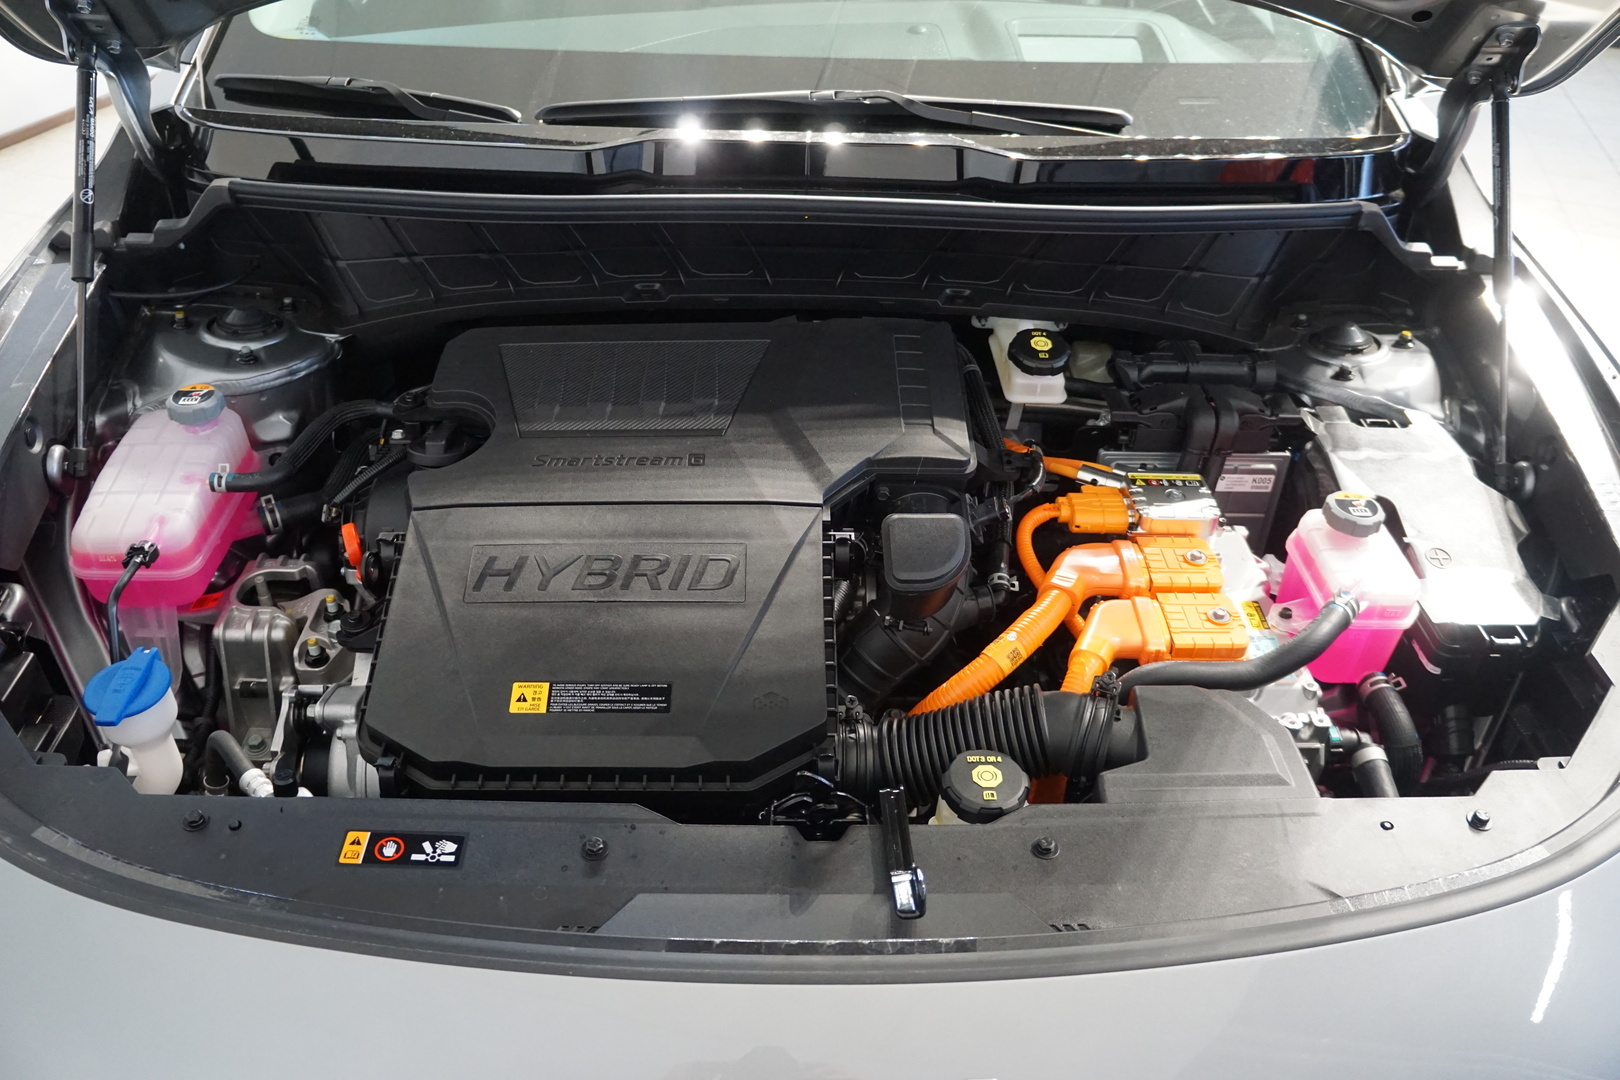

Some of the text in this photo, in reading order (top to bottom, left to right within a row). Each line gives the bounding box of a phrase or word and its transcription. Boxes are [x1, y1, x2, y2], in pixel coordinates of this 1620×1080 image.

[532, 454, 684, 467] Smartstream
[1252, 476, 1272, 485] K005
[472, 554, 741, 592] HYBRID
